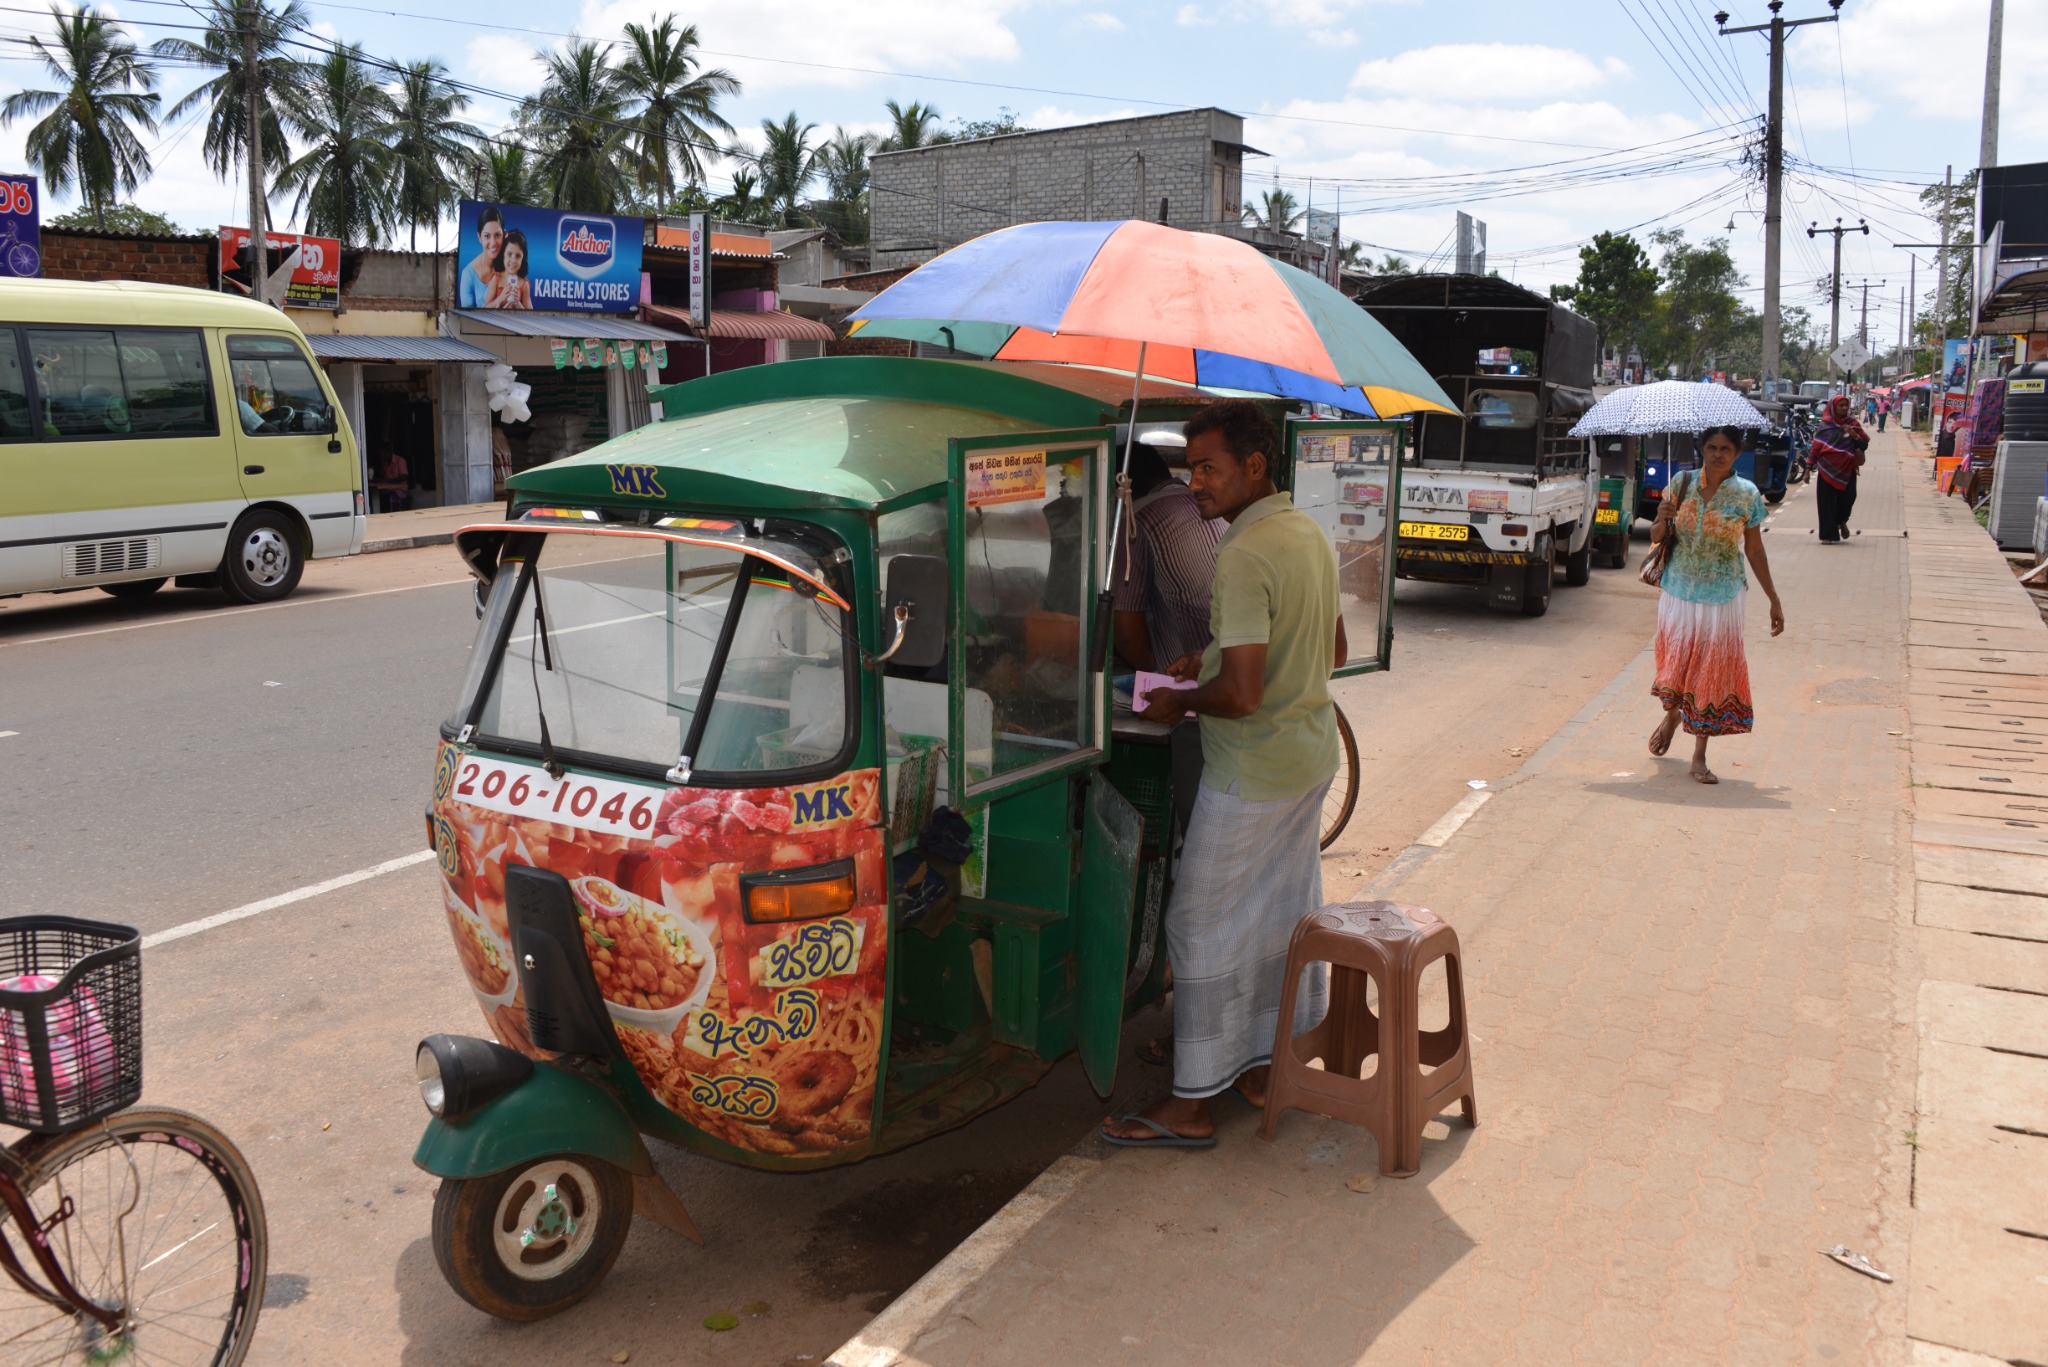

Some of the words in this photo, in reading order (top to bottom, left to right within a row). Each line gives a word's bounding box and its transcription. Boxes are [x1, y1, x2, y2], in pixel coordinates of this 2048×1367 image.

[561, 230, 611, 255] Anchor
[534, 278, 585, 299] KAREEM
[587, 282, 630, 301] STORES
[1510, 365, 1518, 374] P
[607, 464, 666, 498] MK
[1405, 486, 1463, 504] TATA
[1411, 524, 1426, 537] PT
[1438, 526, 1467, 541] 2575
[456, 763, 654, 832] 206-1046
[792, 784, 854, 826] MK
